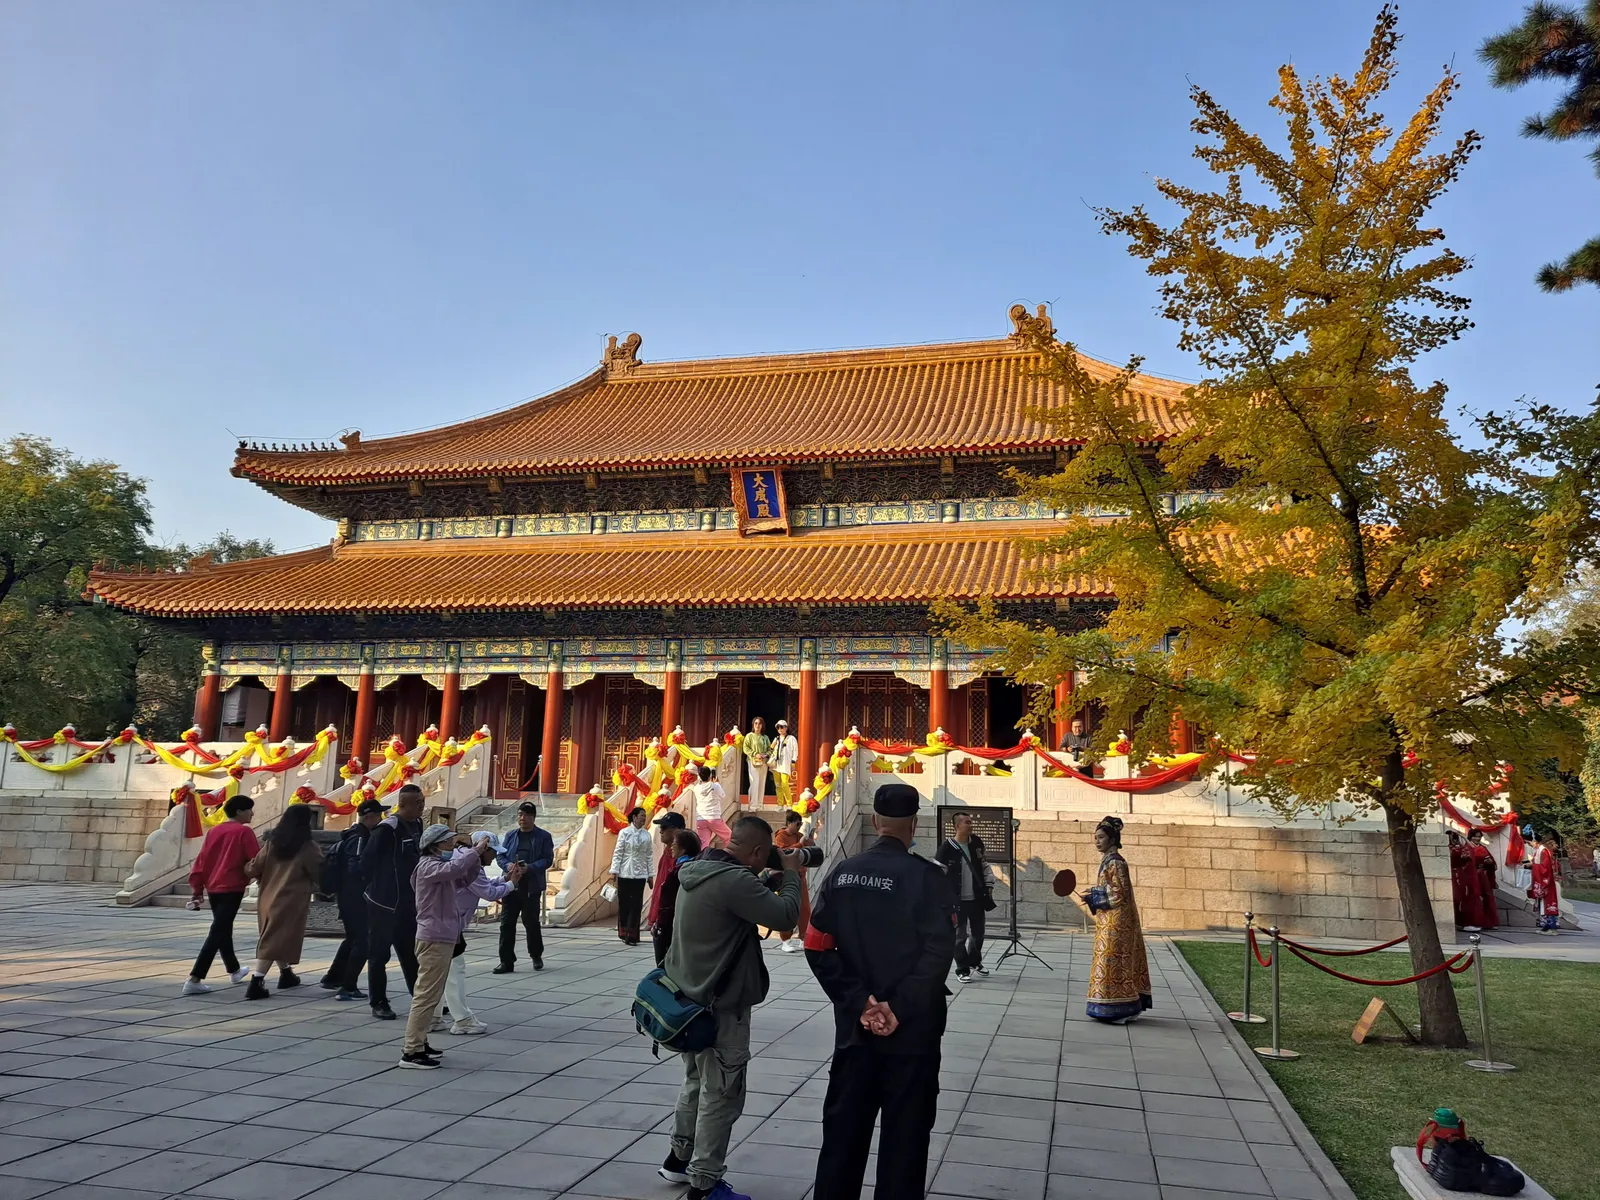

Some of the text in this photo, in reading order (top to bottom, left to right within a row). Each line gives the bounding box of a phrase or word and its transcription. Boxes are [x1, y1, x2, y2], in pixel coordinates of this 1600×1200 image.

[752, 473, 773, 518] 大成殿
[837, 873, 893, 891] 保BAOAN安
